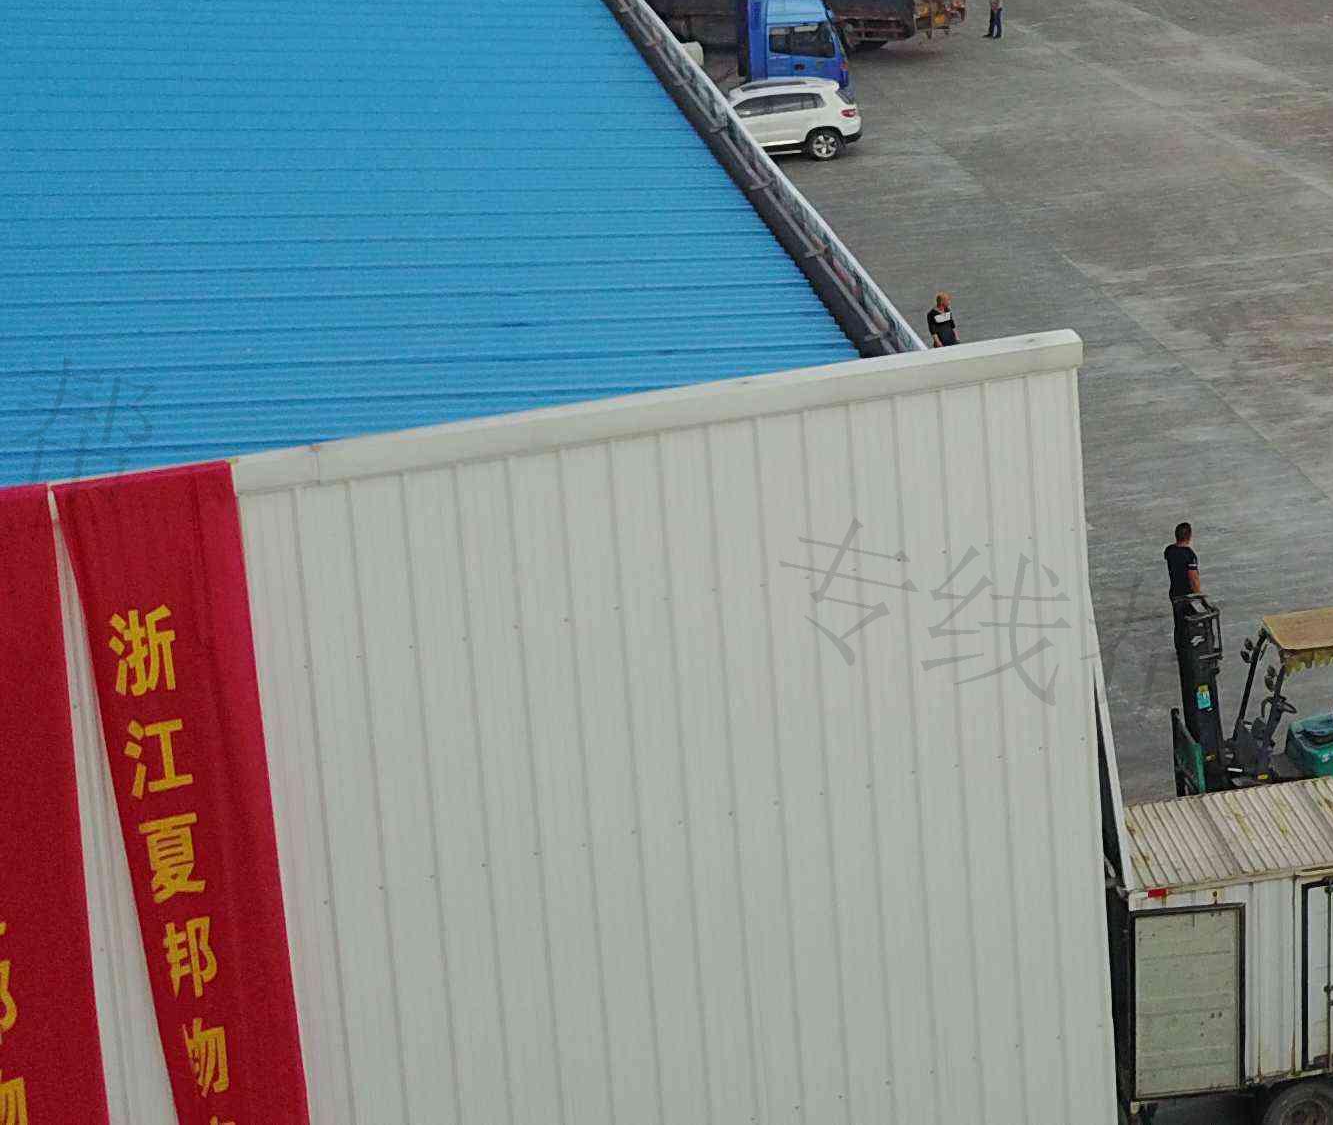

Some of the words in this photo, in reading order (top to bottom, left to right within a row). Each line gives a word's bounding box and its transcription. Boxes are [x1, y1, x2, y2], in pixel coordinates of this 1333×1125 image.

[108, 605, 237, 1125] 浙江夏邦物
